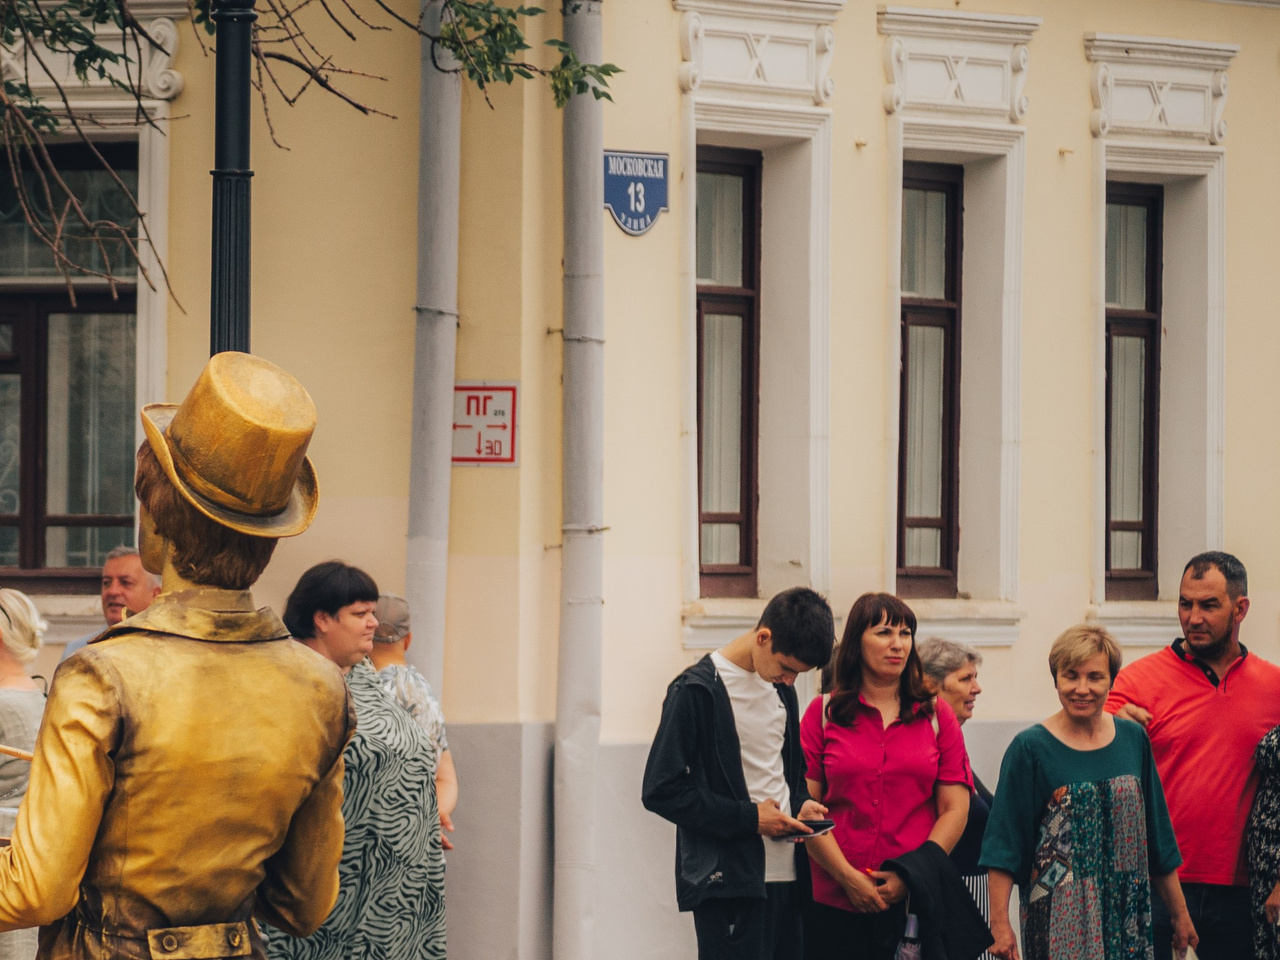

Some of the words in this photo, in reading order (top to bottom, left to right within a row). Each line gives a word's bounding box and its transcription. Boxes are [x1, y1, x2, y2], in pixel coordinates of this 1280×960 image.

[608, 156, 664, 179] МОСКОВСКАЯ
[627, 181, 645, 213] 13
[621, 212, 651, 230] УЛИЦА
[466, 395, 493, 416] ПГ
[485, 440, 502, 455] 30
